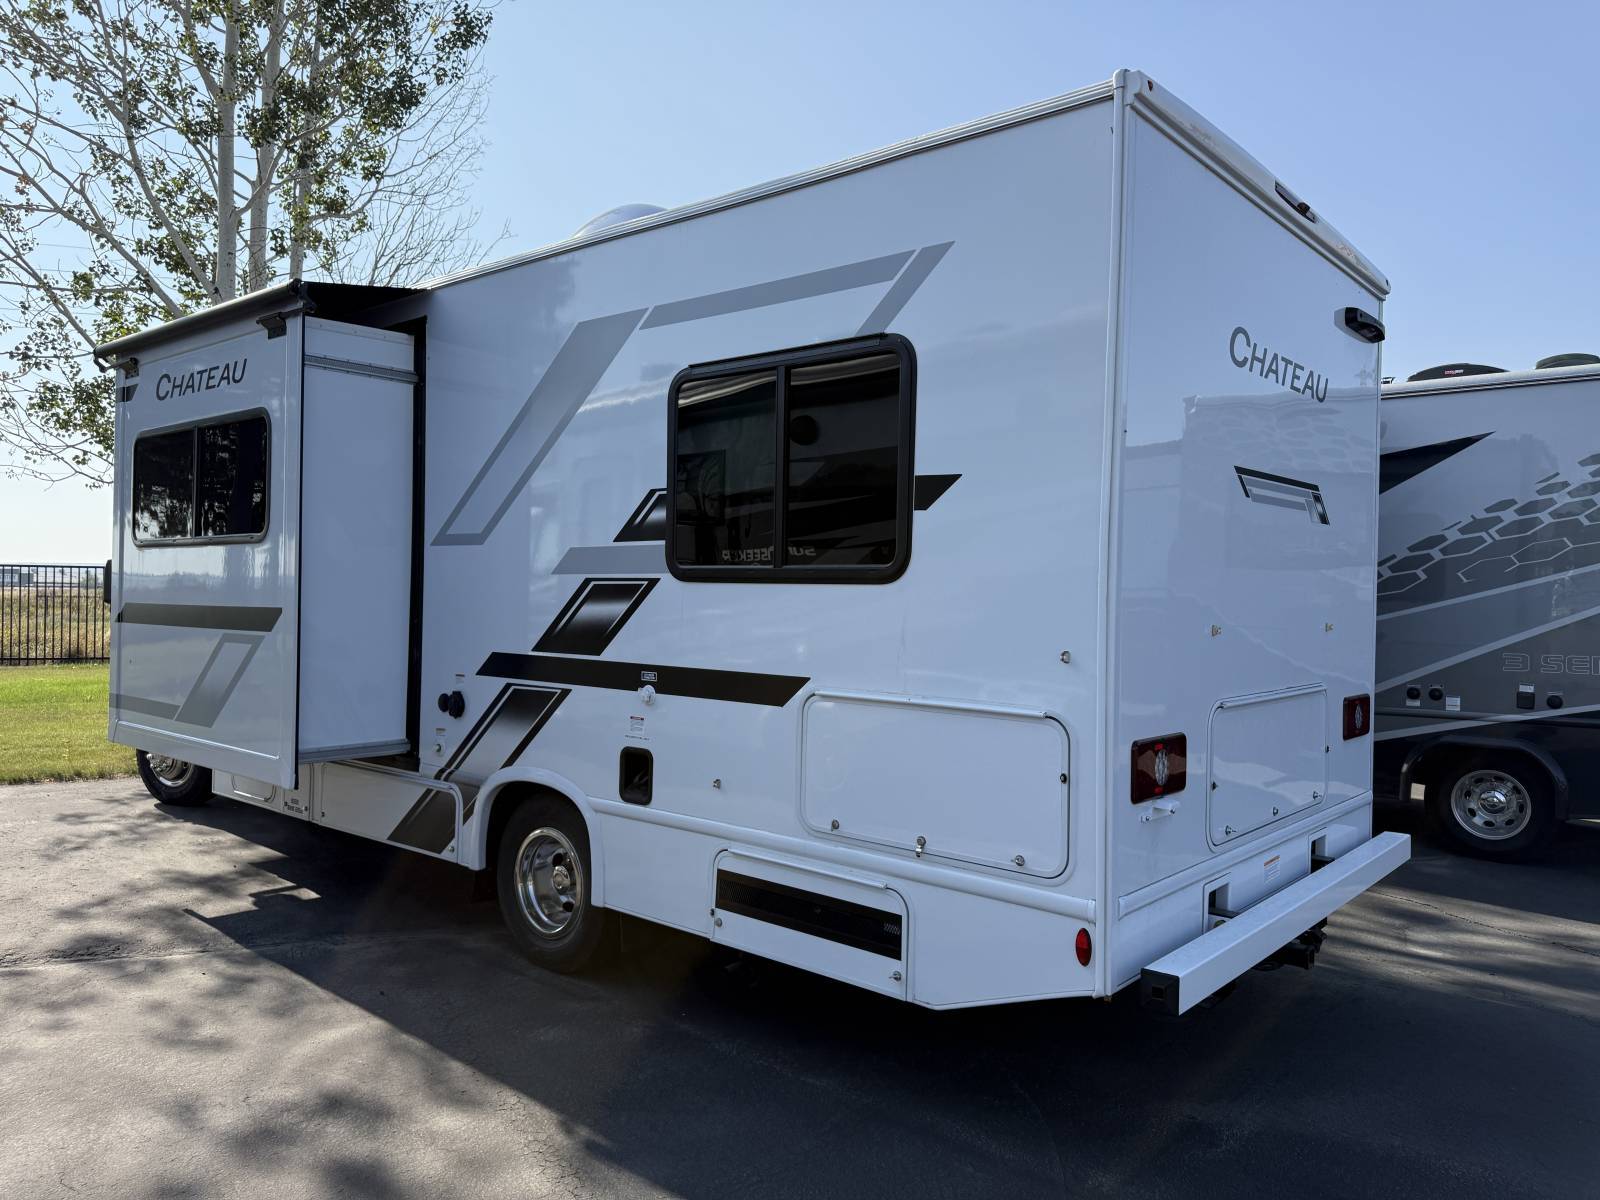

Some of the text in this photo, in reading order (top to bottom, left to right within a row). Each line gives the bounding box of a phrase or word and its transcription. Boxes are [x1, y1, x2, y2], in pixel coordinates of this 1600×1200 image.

[155, 358, 248, 401] CHATEAU
[1229, 326, 1329, 403] CHATEAU
[1502, 653, 1530, 672] 3
